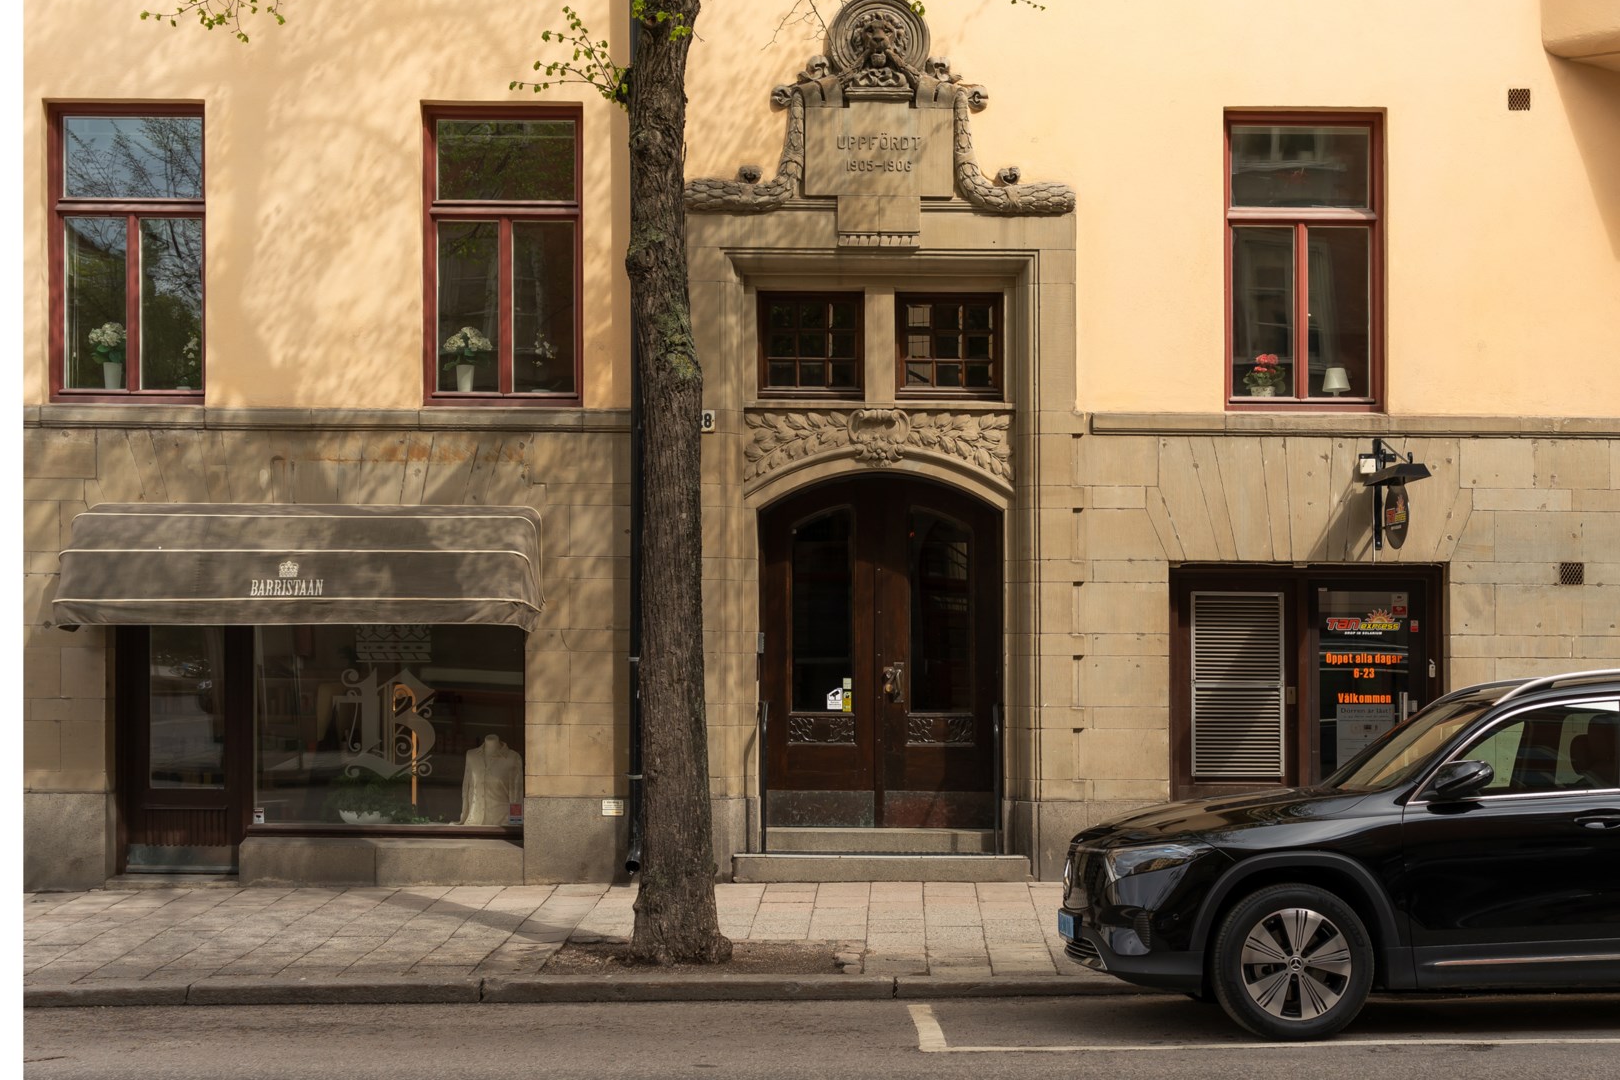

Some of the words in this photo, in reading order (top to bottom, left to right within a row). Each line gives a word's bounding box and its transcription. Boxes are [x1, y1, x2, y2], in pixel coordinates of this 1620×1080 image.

[836, 132, 921, 151] UPPFÖRDT
[700, 413, 713, 428] 8
[250, 579, 324, 596] BARRISTAAN
[1355, 653, 1373, 663] alla
[1375, 653, 1403, 665] dagar
[1353, 668, 1375, 678] 6-23
[1337, 693, 1392, 703] Välkommen
